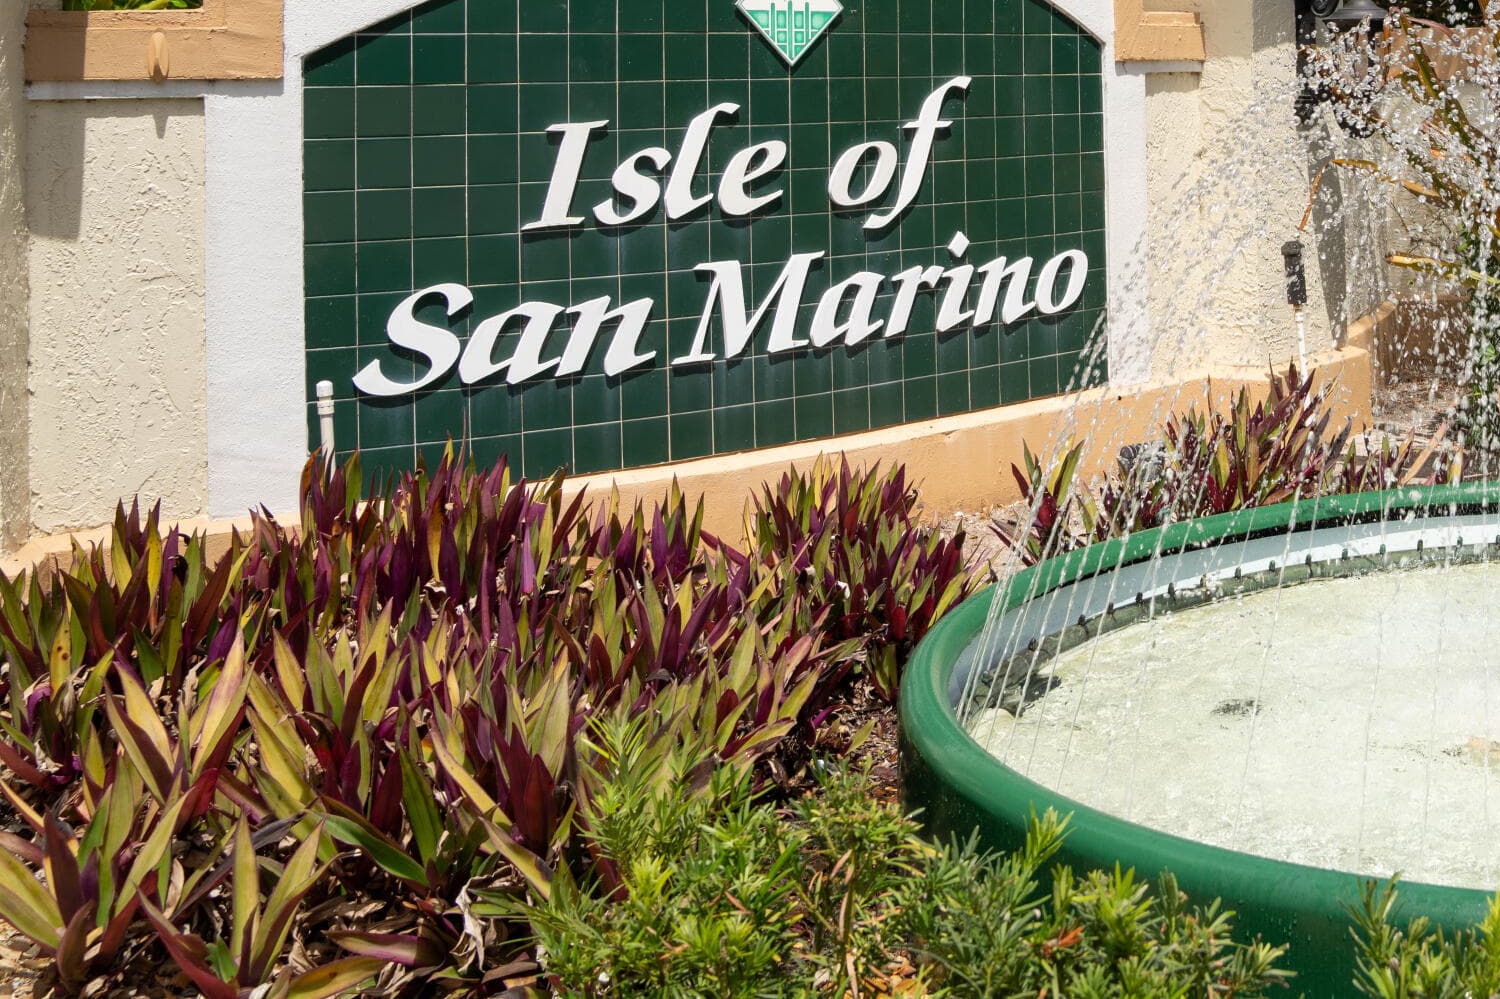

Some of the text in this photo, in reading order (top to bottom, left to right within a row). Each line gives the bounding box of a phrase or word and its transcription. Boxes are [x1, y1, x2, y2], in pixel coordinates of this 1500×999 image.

[521, 75, 973, 231] Isle of
[353, 230, 1088, 397] San Marino
